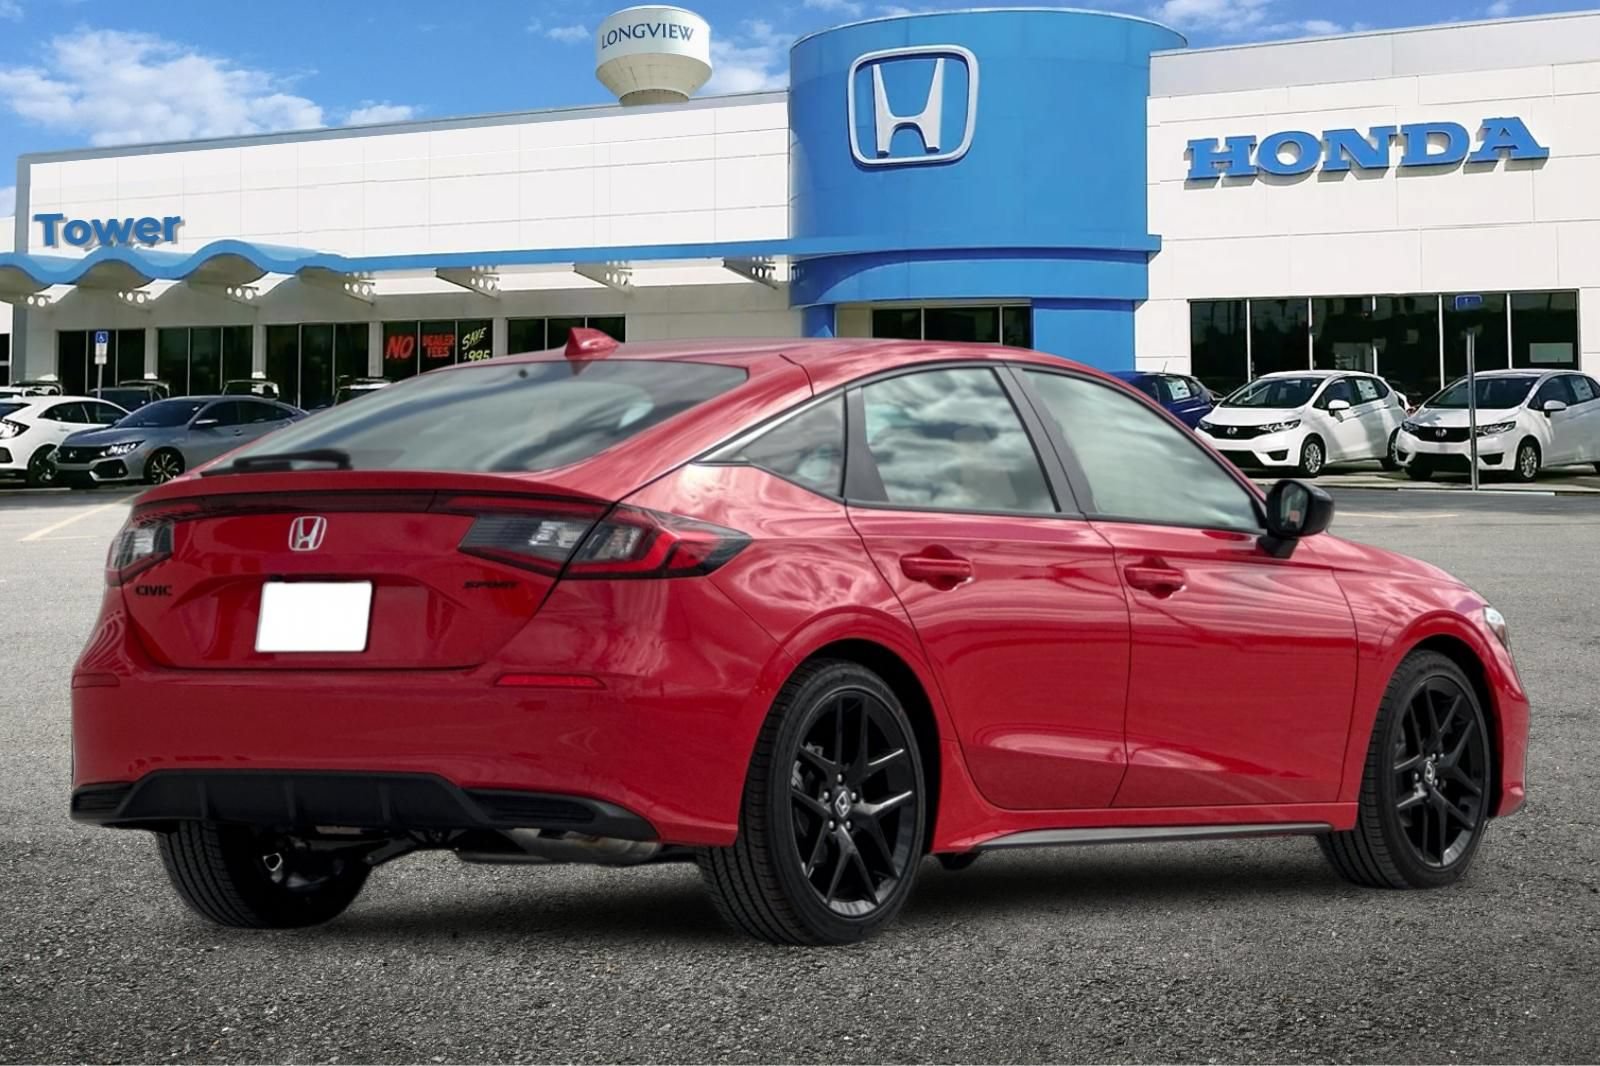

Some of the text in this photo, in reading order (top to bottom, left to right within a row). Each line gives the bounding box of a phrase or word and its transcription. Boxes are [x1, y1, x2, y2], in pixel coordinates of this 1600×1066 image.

[602, 23, 694, 49] LONGVIEW
[1185, 116, 1550, 188] HONDA
[33, 213, 184, 248] Tower
[385, 335, 415, 360] NO
[461, 327, 487, 350] SAVE
[135, 584, 173, 597] CIVIC
